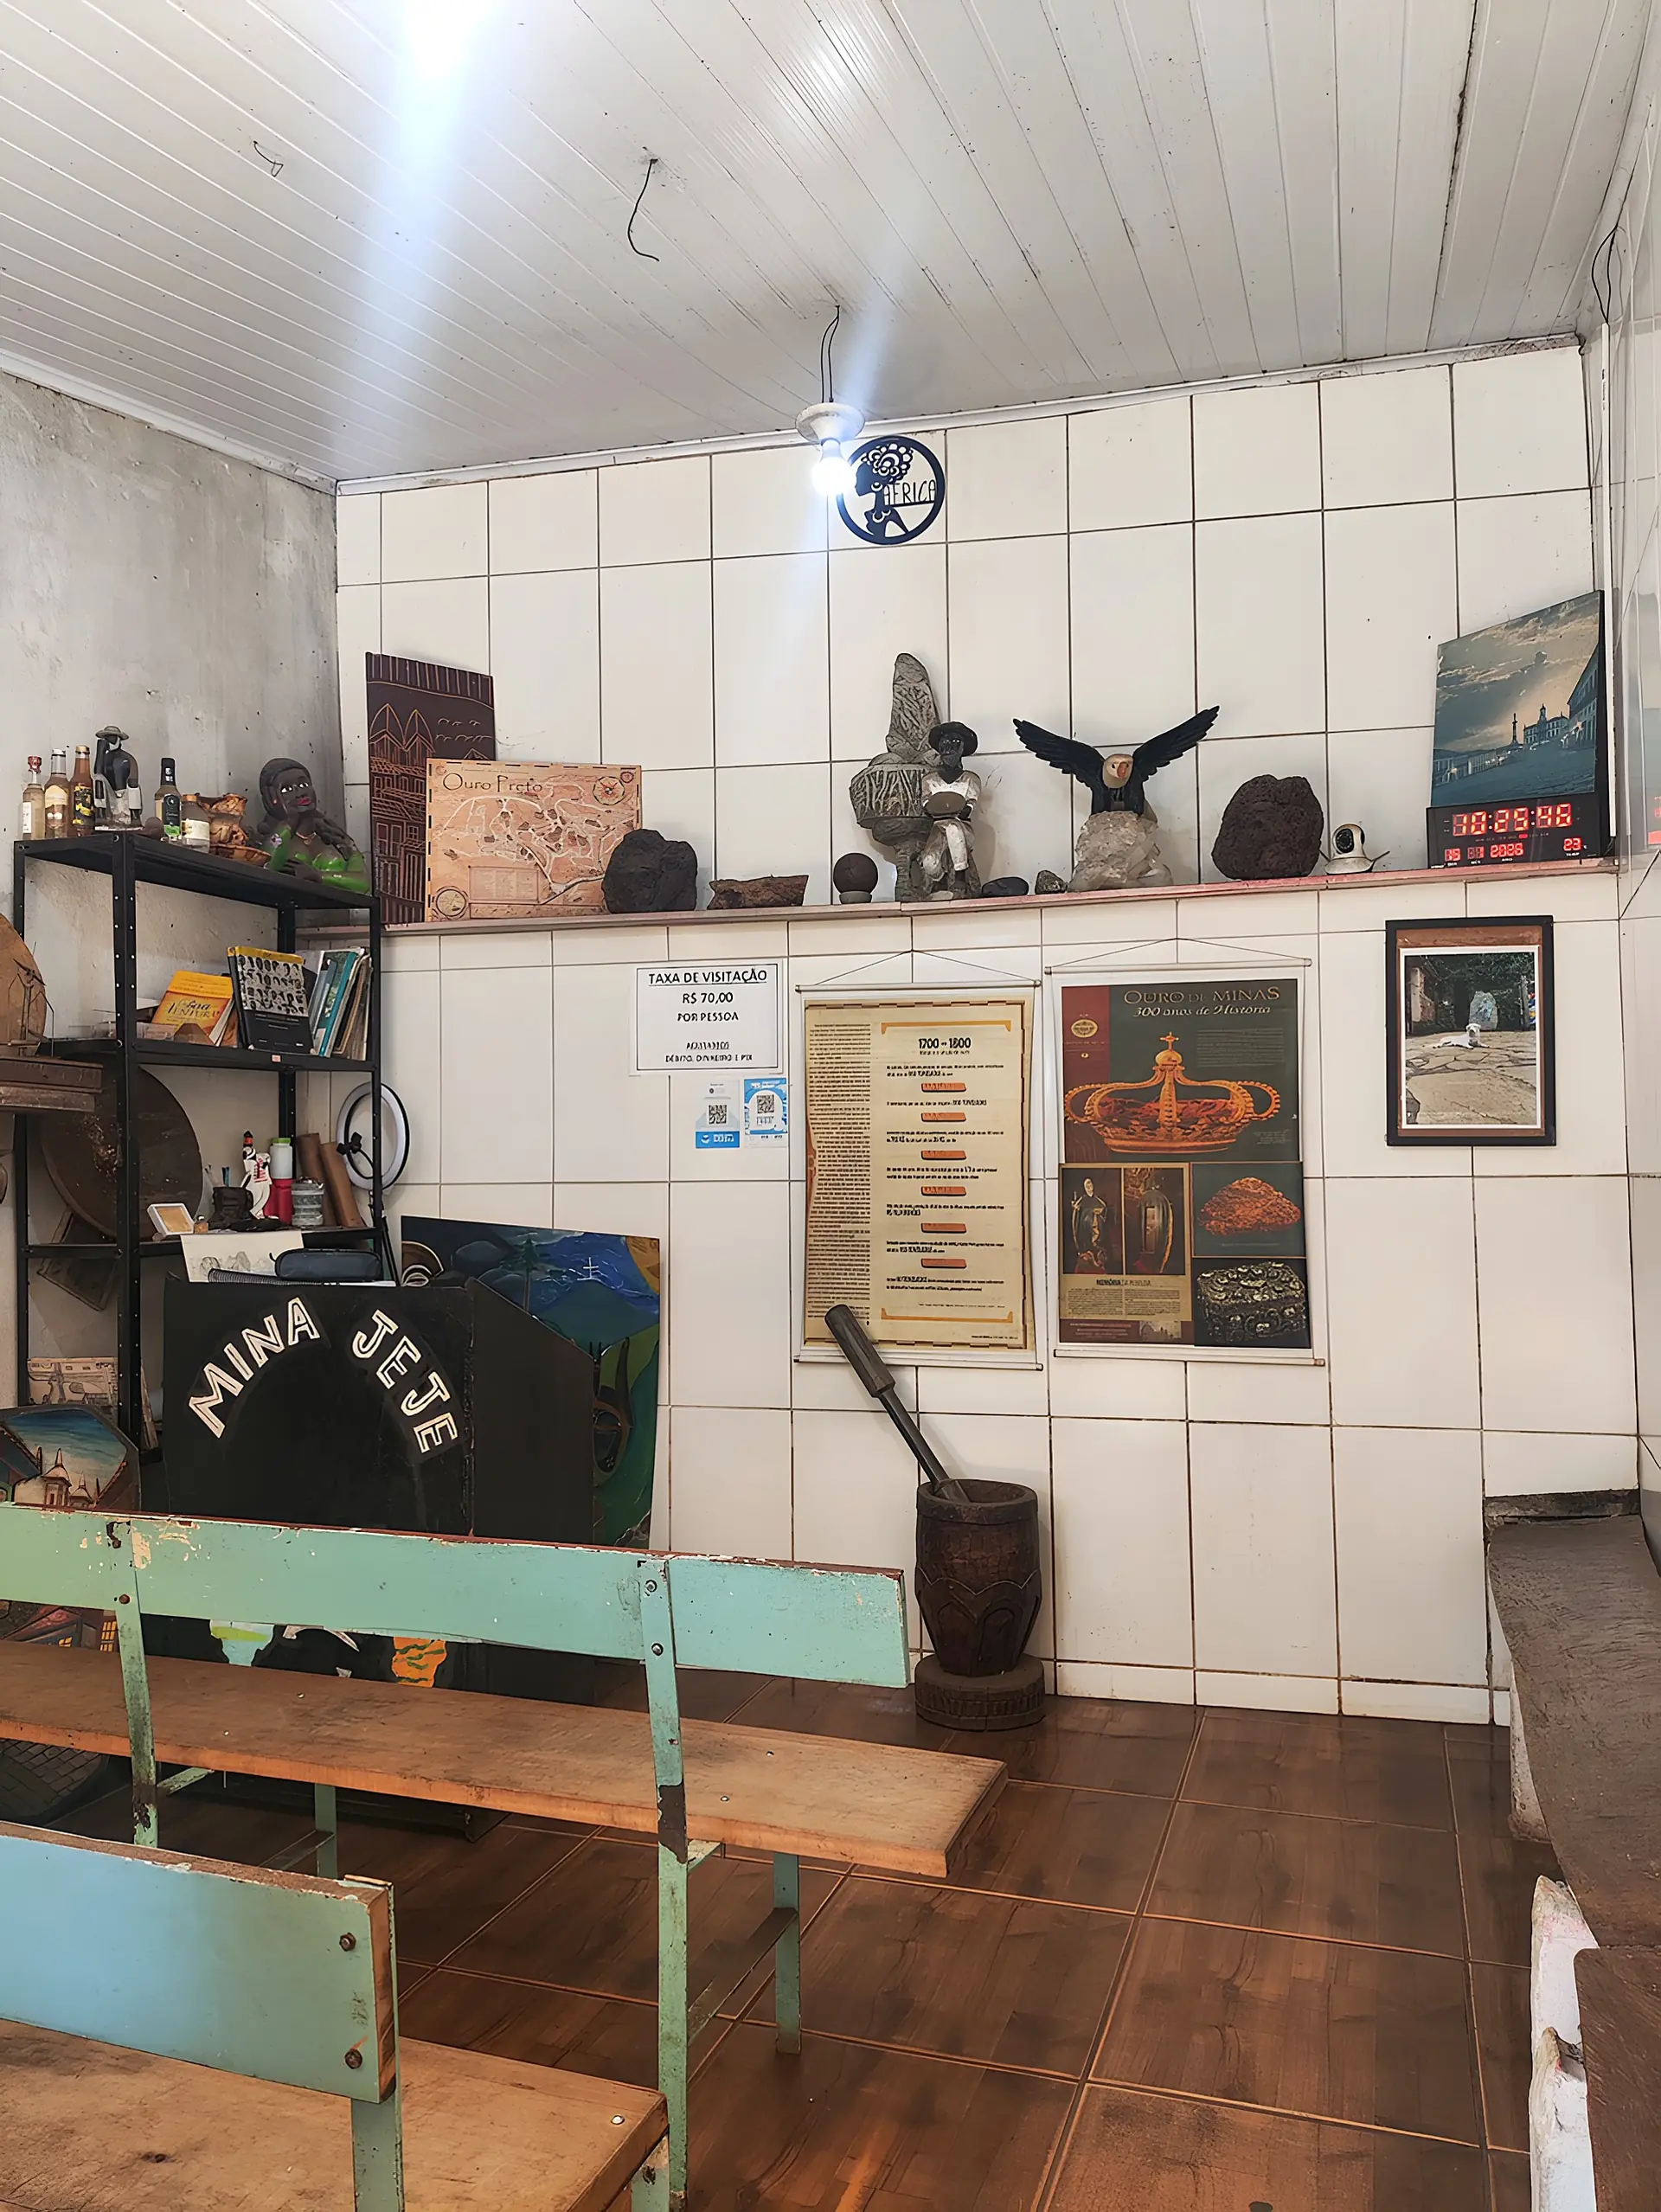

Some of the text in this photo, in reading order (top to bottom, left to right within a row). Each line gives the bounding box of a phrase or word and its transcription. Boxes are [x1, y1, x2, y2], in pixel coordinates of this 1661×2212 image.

[442, 773, 542, 792] Ouro Preto
[1490, 843, 1524, 858] 2025
[1563, 837, 1582, 851] 23
[649, 968, 767, 984] TAXA DE VISITAÇÃO
[682, 991, 734, 1004] R$ 70,00
[1124, 990, 1184, 1004] OURO
[1212, 986, 1280, 1002] MINAS
[677, 1011, 739, 1022] POR PESSOA
[1133, 1006, 1161, 1017] 300
[1163, 1008, 1192, 1016] anos
[1196, 1007, 1210, 1016] de
[918, 1038, 939, 1048] 1700
[189, 1297, 458, 1453] MINA JEJE
